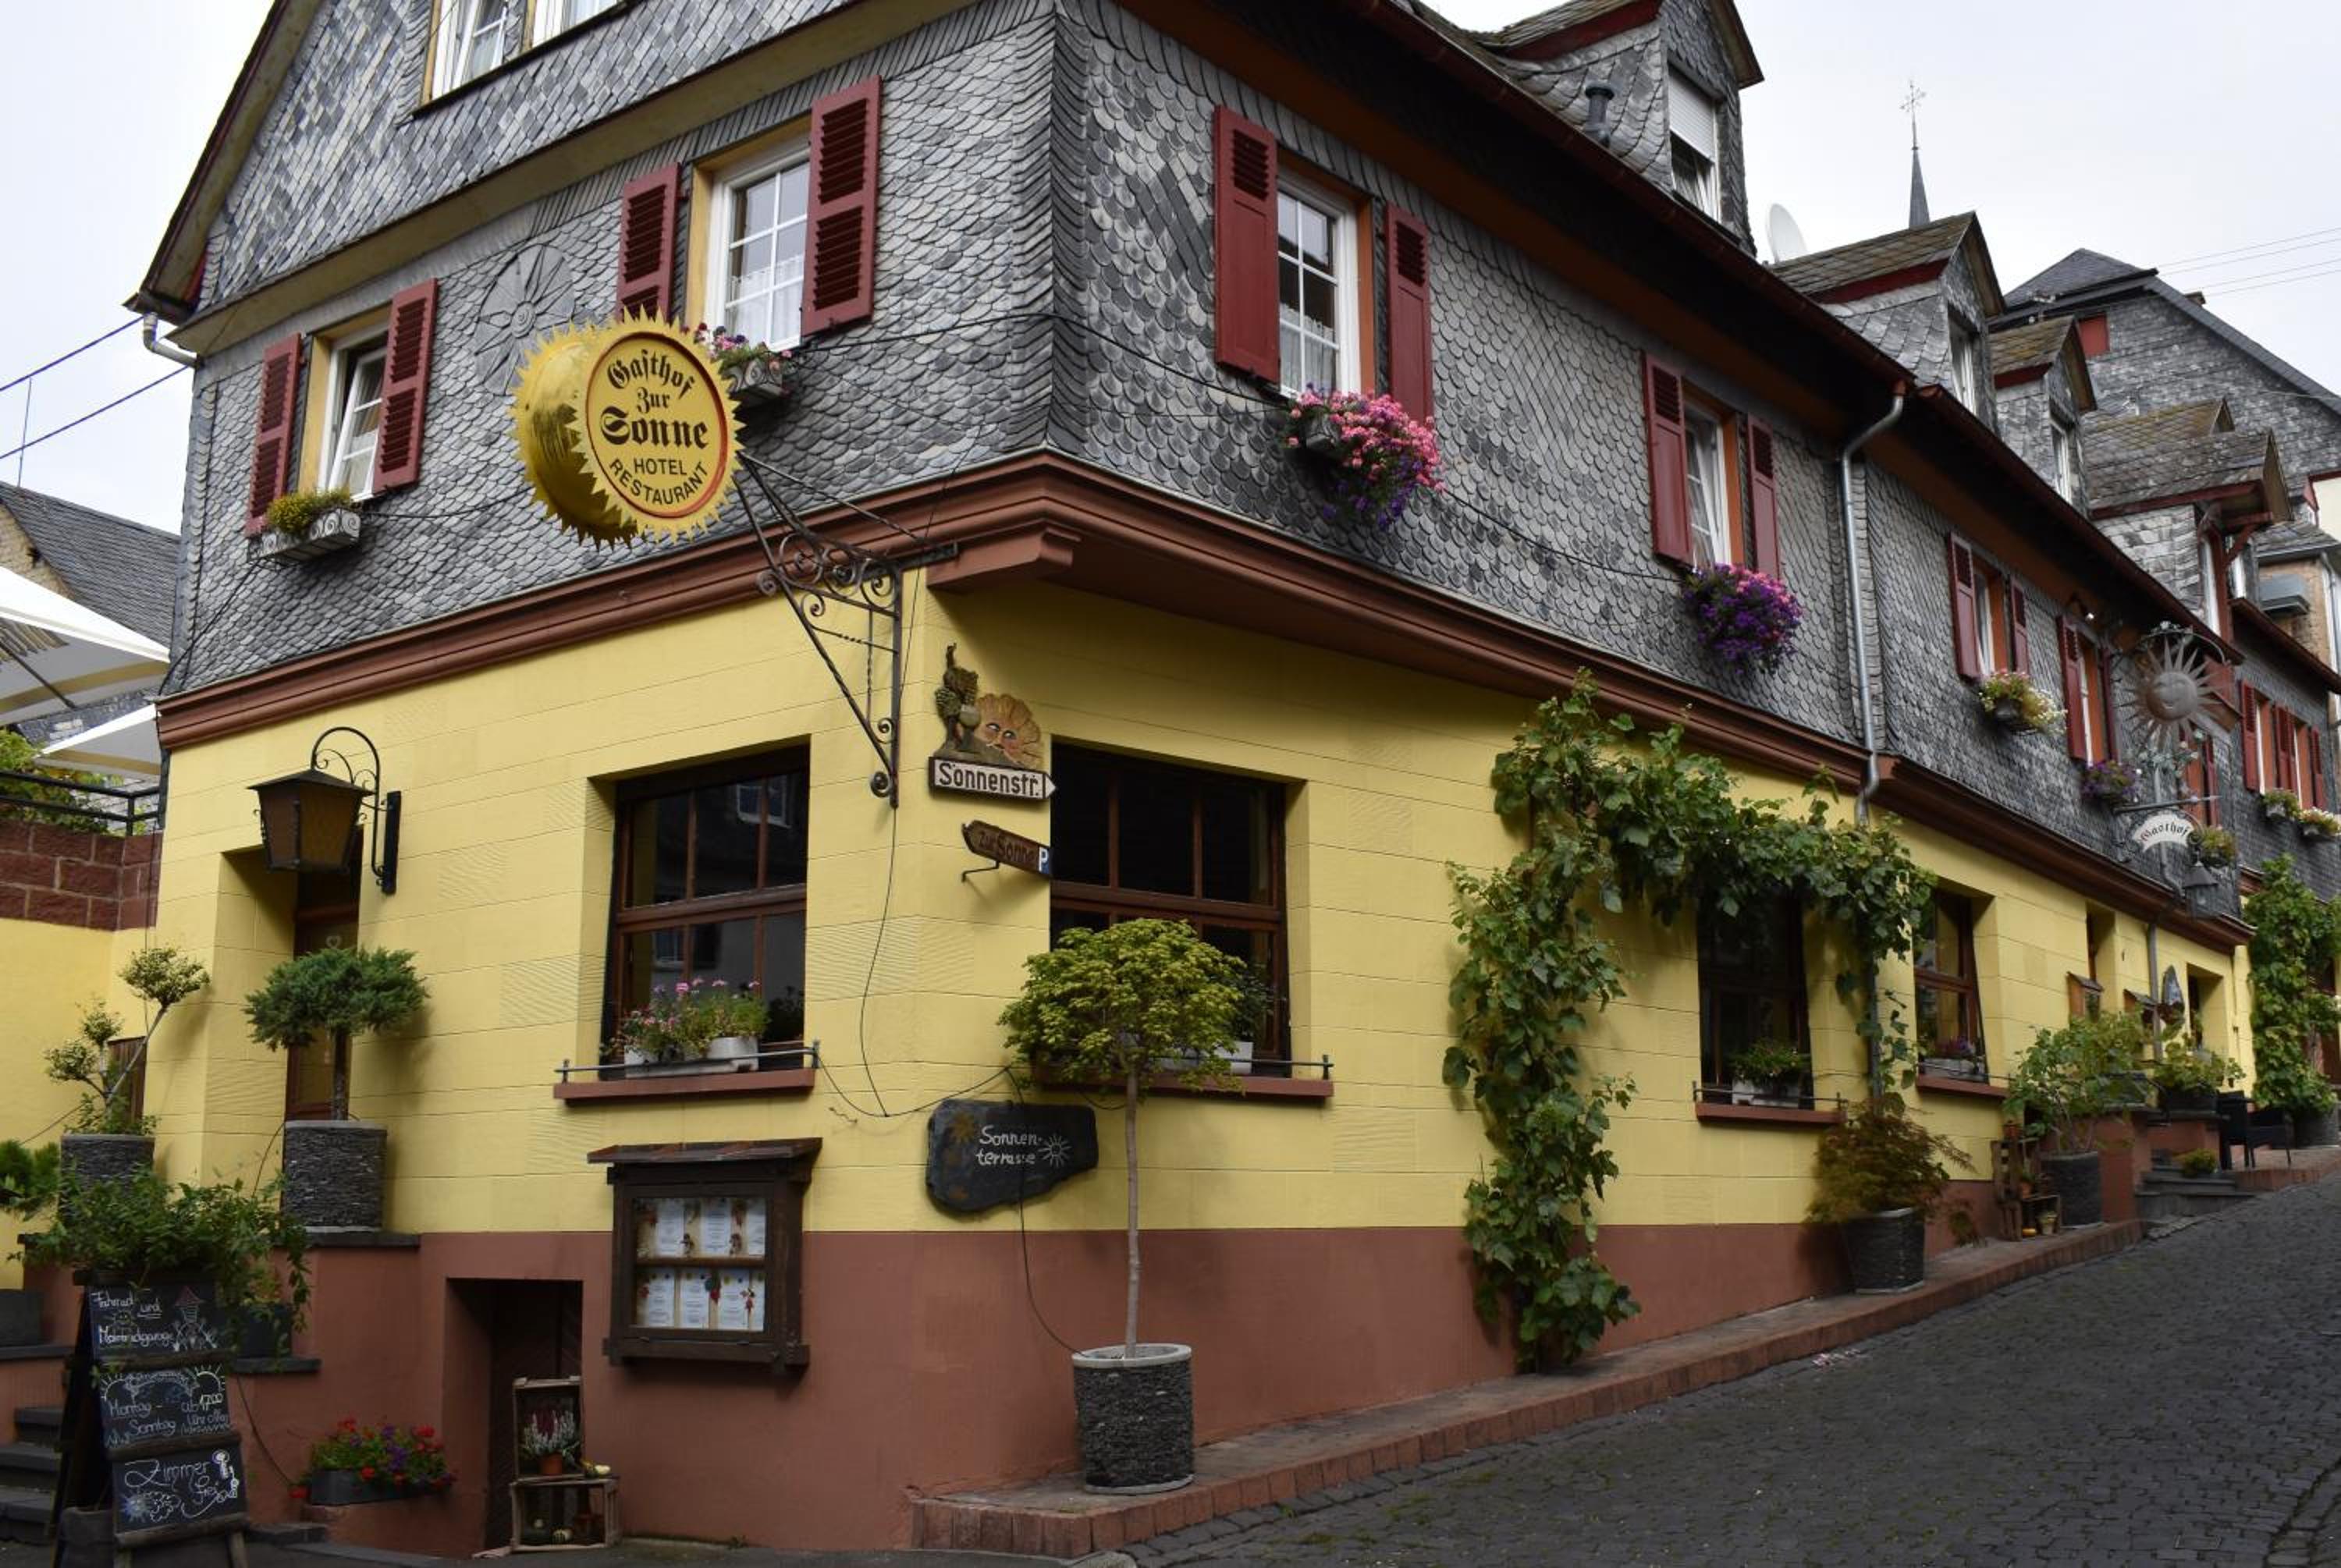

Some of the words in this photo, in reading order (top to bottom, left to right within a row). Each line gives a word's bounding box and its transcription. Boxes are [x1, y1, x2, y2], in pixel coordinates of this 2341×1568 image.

[637, 387, 670, 413] Zur
[600, 406, 709, 449] Sonne
[609, 459, 709, 505] RESTAURANT
[634, 458, 687, 476] HOTEL
[939, 762, 1040, 796] Sonnenstr.
[124, 1458, 211, 1488] Zimmer
